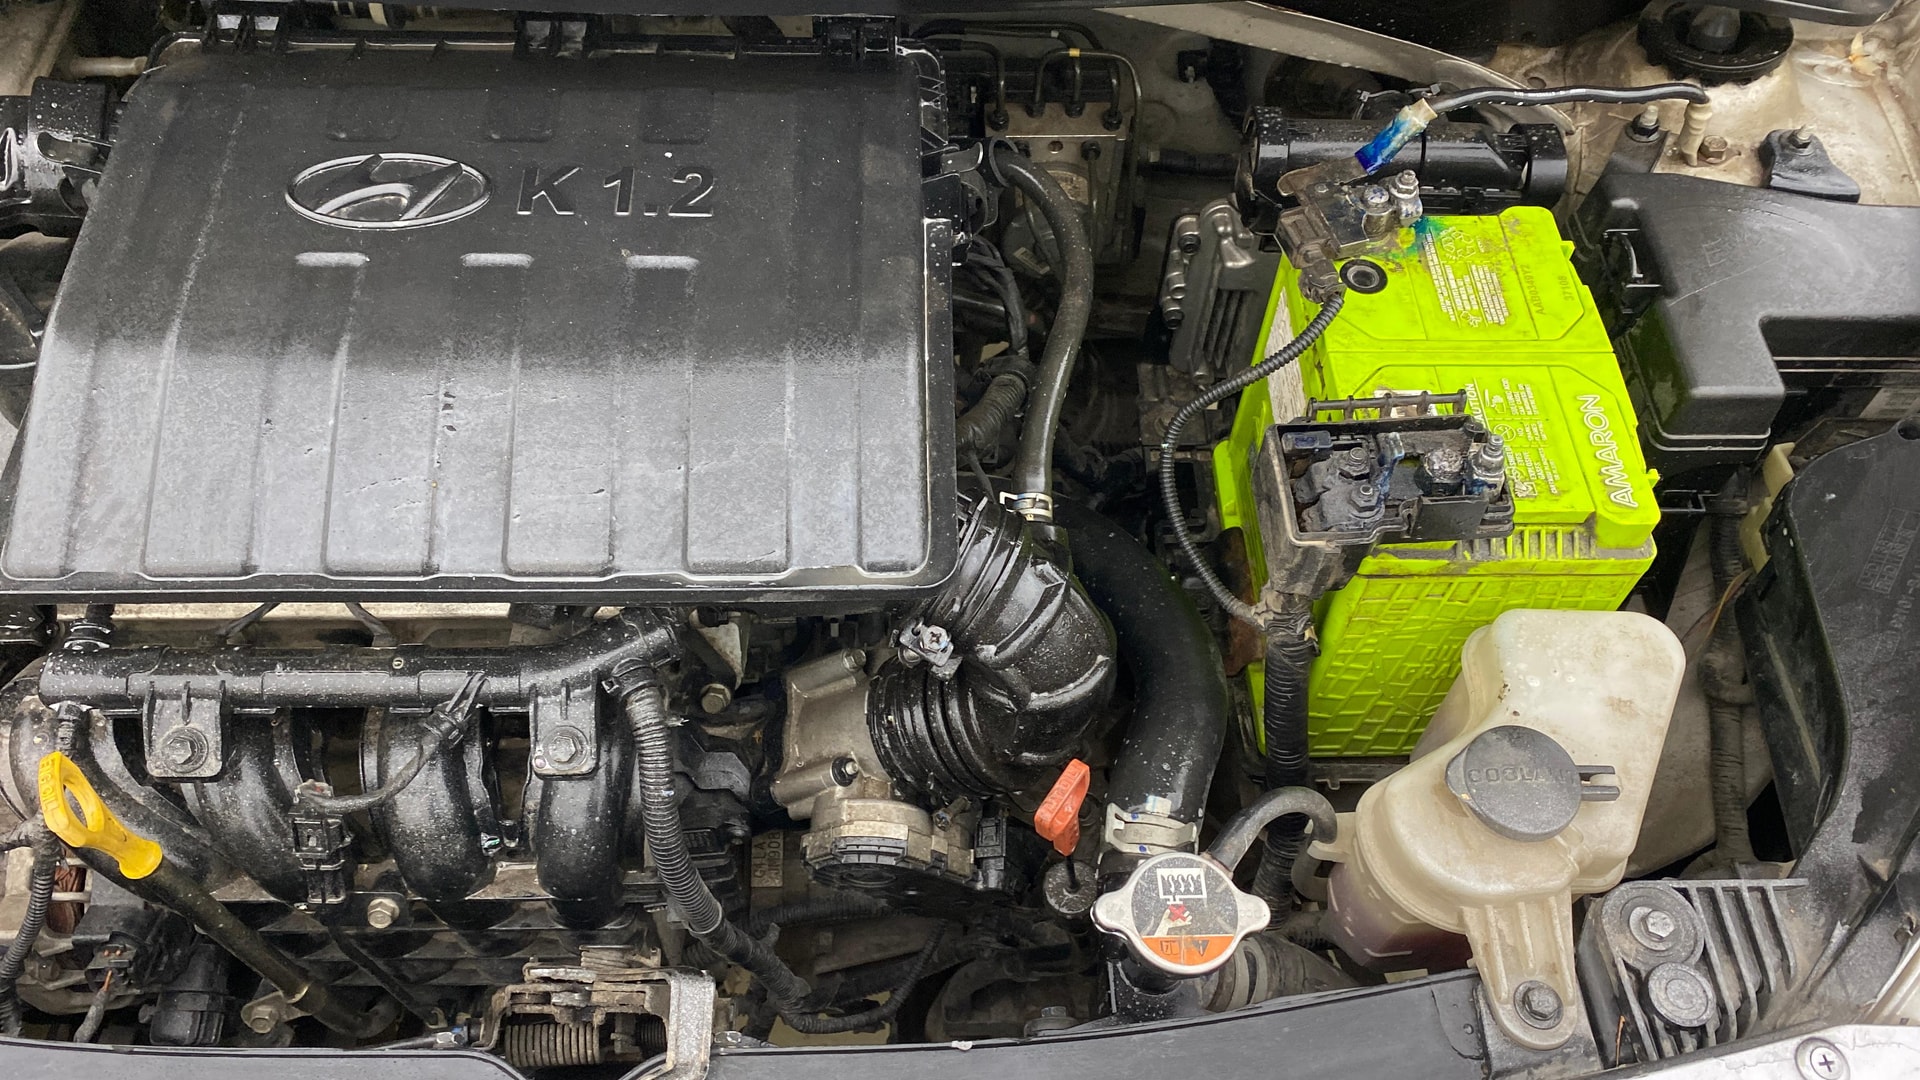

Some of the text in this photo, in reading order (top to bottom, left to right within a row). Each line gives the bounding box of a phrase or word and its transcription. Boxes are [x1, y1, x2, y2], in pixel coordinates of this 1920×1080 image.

[516, 166, 715, 217] K 1.2
[1576, 394, 1639, 508] AMARON
